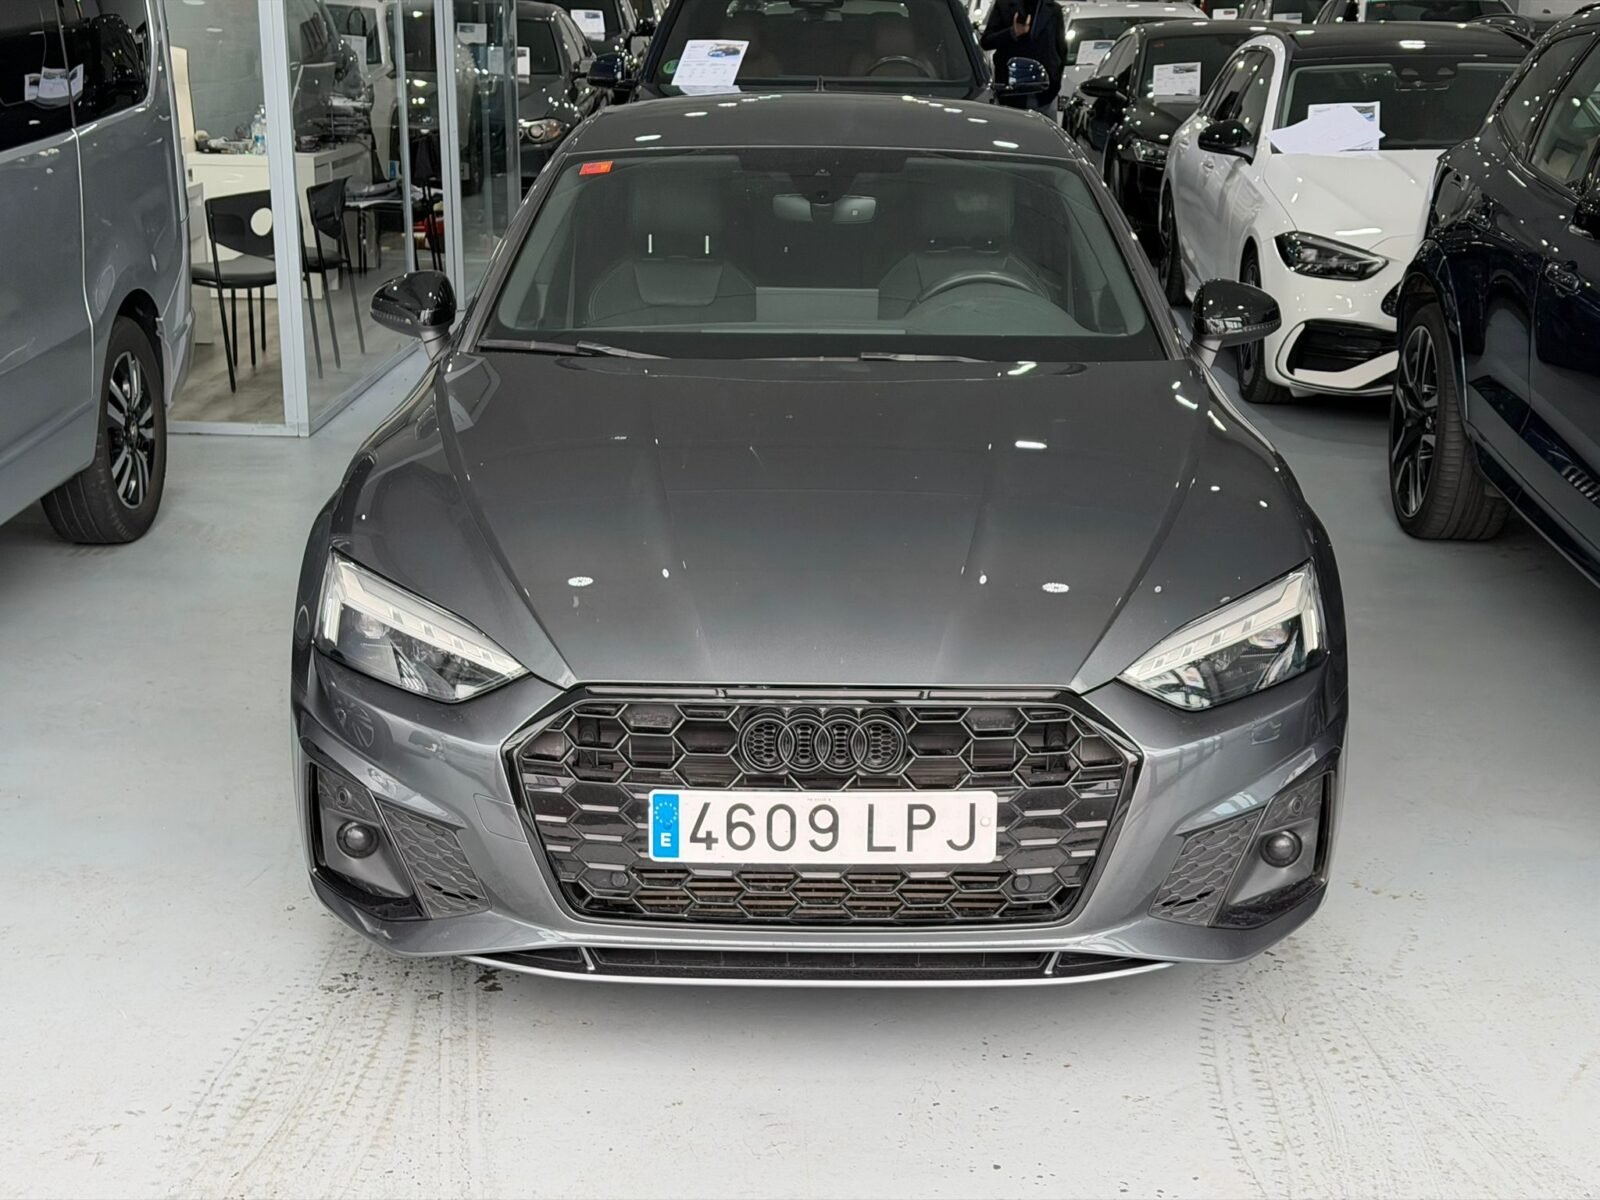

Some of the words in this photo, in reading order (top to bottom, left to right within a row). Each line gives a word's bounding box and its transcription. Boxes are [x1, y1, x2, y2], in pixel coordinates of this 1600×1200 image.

[660, 832, 672, 848] E
[689, 802, 839, 851] 4609
[867, 803, 976, 852] LPJ
